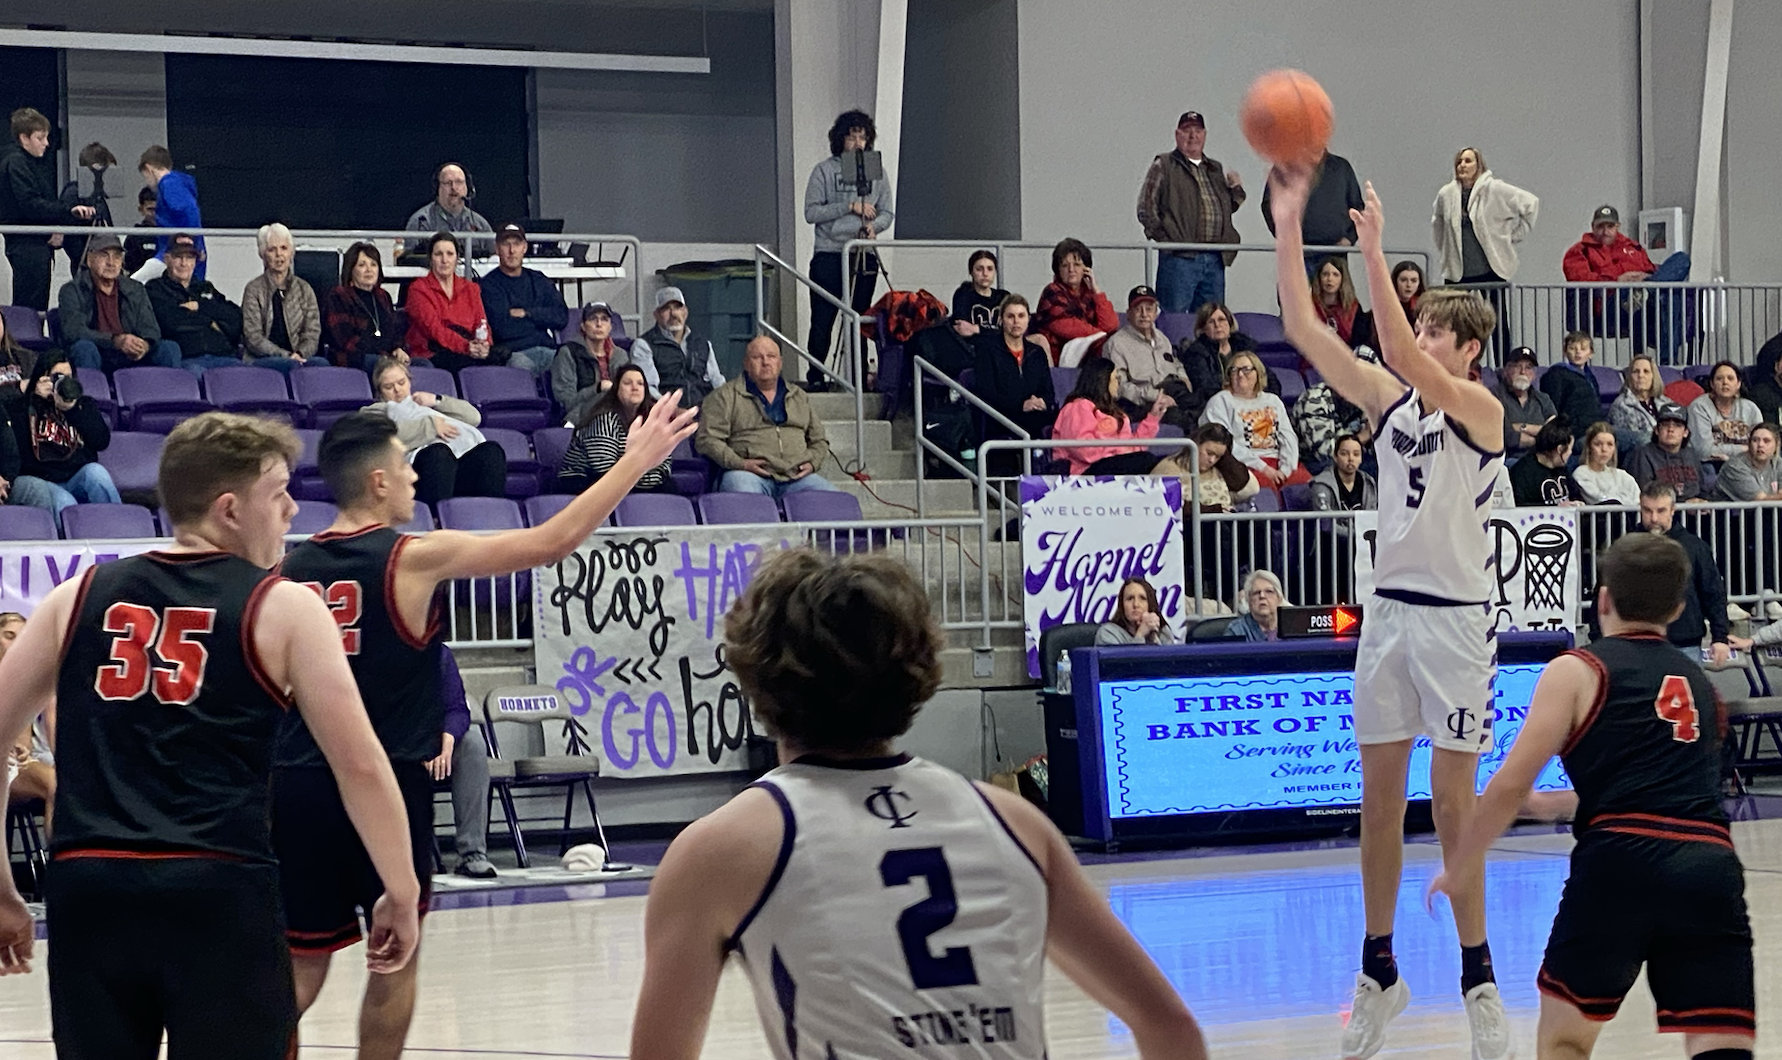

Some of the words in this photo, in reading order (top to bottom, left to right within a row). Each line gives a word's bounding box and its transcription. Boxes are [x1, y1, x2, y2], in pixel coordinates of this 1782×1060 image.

[1042, 506, 1133, 516] WELCOME
[1143, 506, 1163, 516] TO
[1406, 465, 1426, 509] 5
[1025, 518, 1175, 595] Hornet
[551, 549, 675, 657] Play
[673, 541, 790, 639] HA
[1040, 575, 1182, 630] Nan
[94, 601, 217, 706] 35
[556, 646, 617, 716] OR
[499, 696, 558, 711] HORNETS
[601, 691, 677, 770] GO
[678, 656, 756, 765] ho
[1147, 719, 1261, 741] BANK
[1273, 716, 1327, 734] OF
[1174, 692, 1289, 713] FIRST
[1654, 674, 1701, 743] 4
[1224, 741, 1317, 760] Serving
[1270, 762, 1336, 778] Since
[1283, 781, 1352, 794] MEMBER
[878, 846, 980, 991] 2
